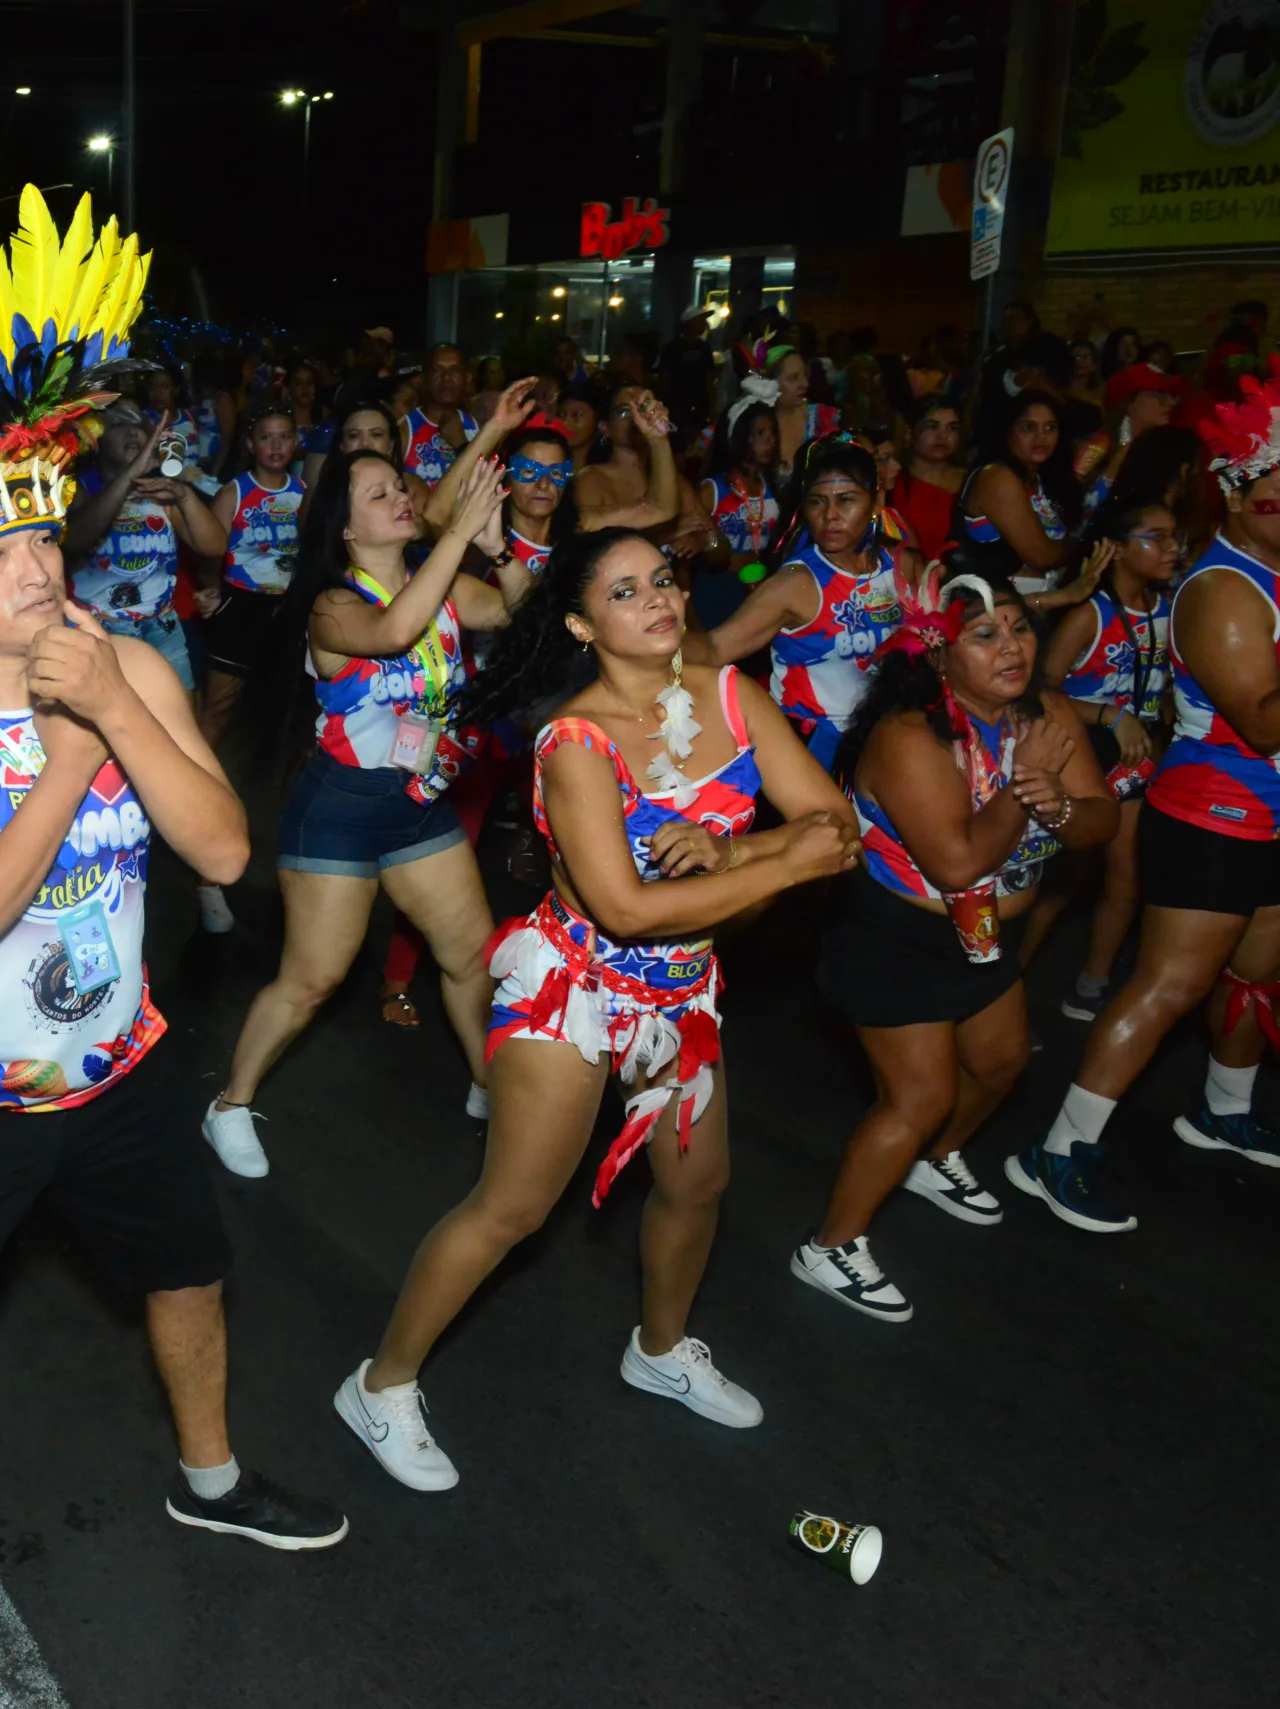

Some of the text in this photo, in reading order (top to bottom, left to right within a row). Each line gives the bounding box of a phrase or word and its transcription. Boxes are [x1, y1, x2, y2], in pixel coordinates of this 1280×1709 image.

[1108, 203, 1183, 227] SEJAM
[580, 197, 670, 260] Bob's
[242, 525, 273, 543] BOI
[870, 606, 901, 623] BLOCO
[834, 629, 877, 657] BOI
[369, 670, 416, 703] BOI
[42, 1004, 68, 1020] CANTOS
[71, 1011, 83, 1020] DO
